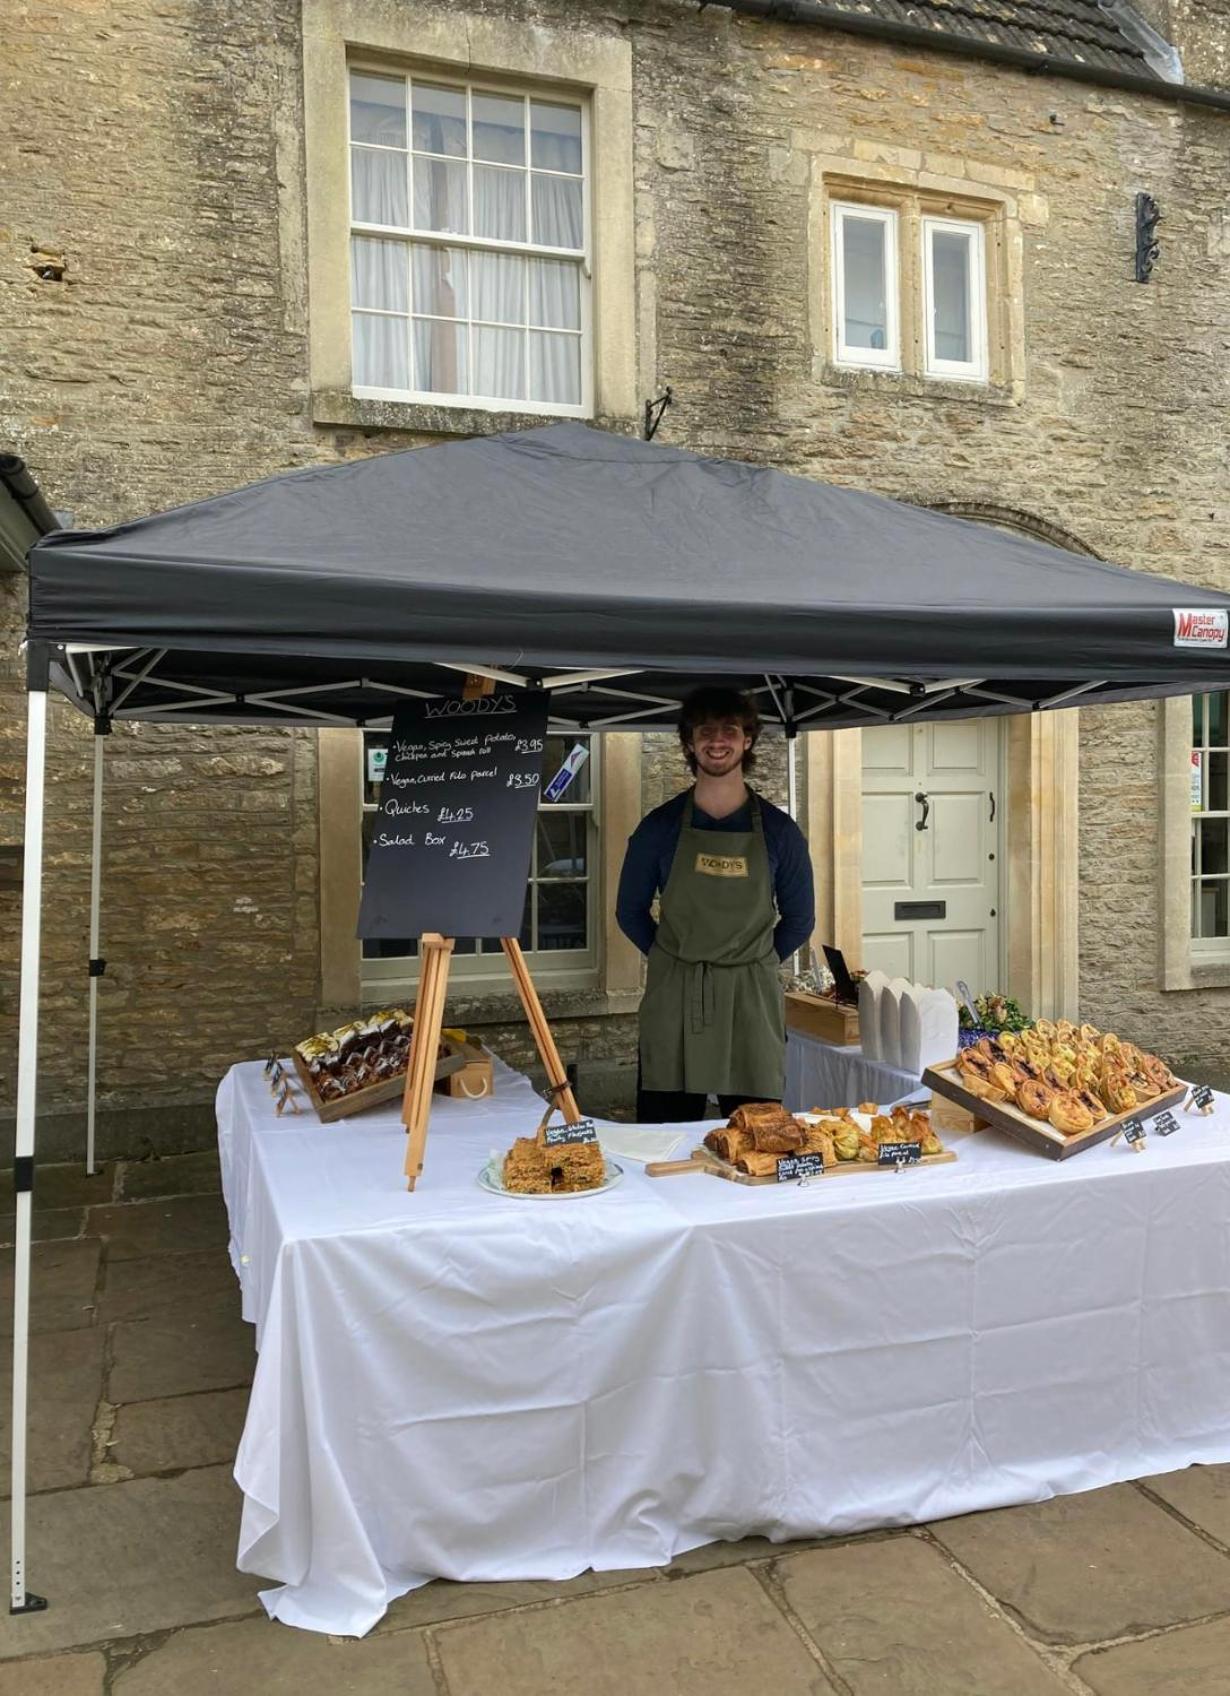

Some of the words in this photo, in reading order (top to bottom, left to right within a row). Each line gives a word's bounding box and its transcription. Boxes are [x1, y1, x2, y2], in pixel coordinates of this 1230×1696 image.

[1178, 613, 1215, 637] Master
[1192, 625, 1224, 642] Canopy
[424, 695, 517, 717] WOODYS
[385, 799, 430, 817] Quiches
[437, 807, 474, 823] £4.25
[379, 833, 415, 847] Salad
[425, 832, 446, 846] Box
[449, 841, 490, 858] £4.75
